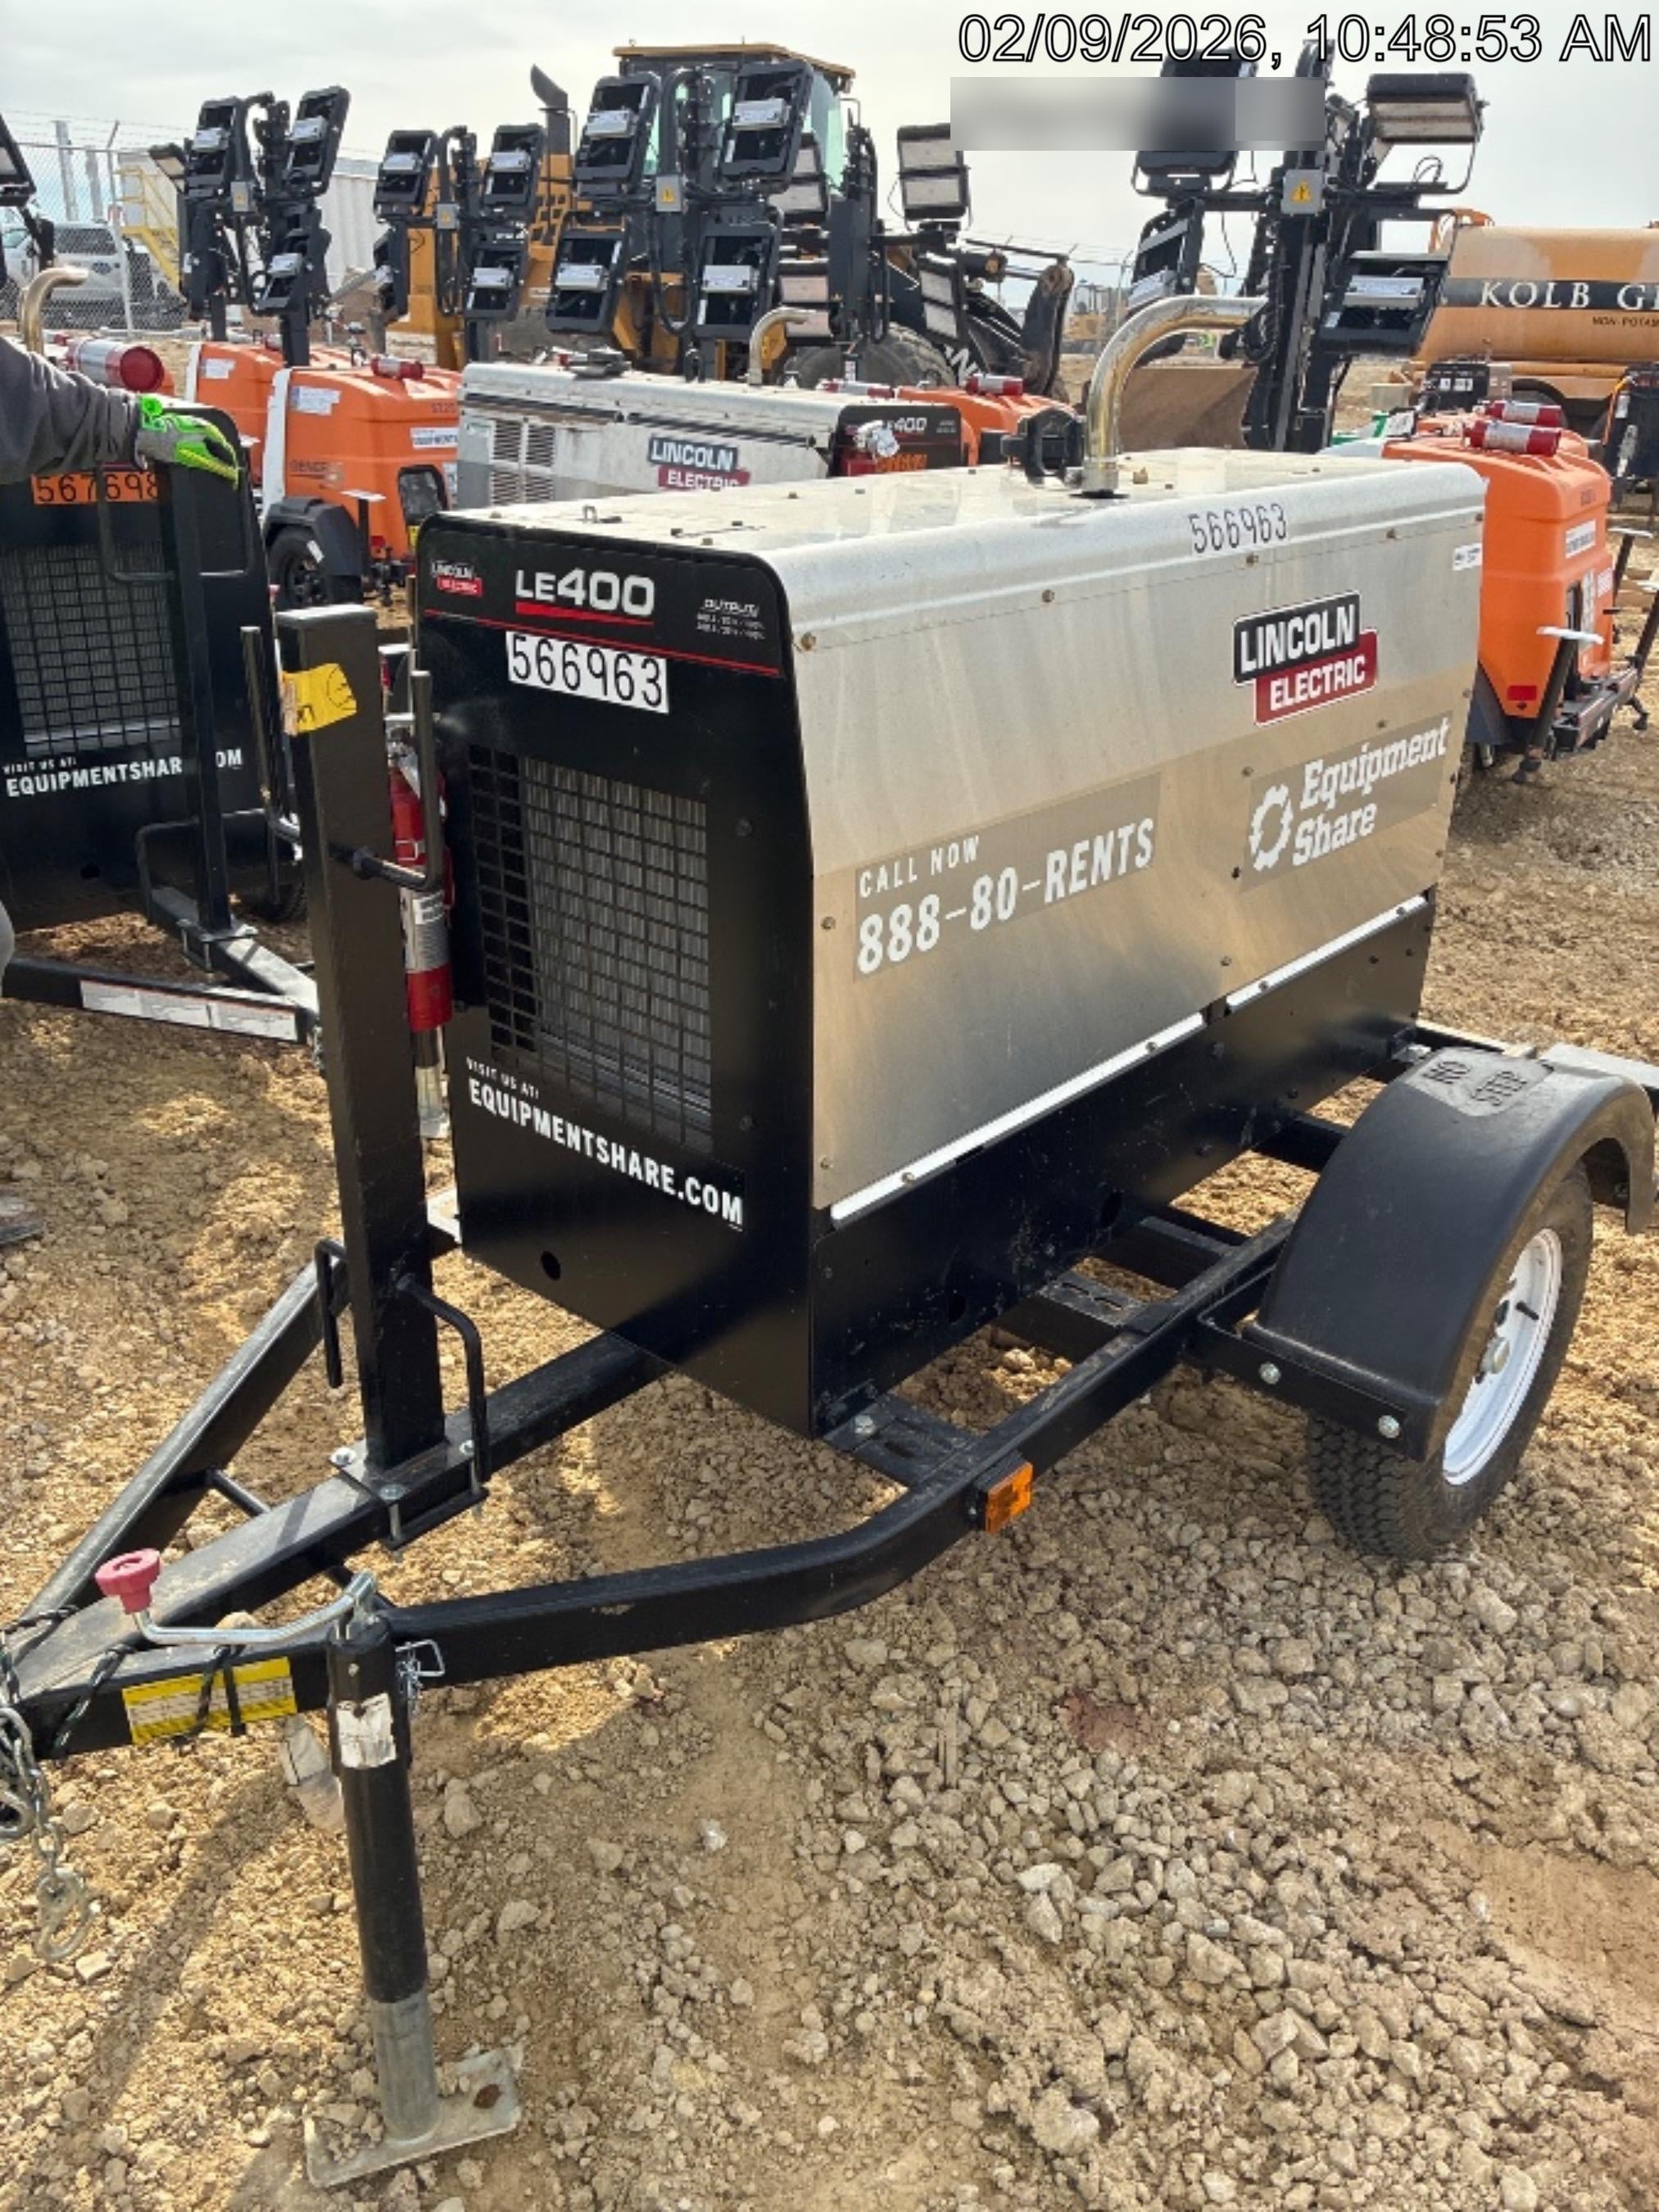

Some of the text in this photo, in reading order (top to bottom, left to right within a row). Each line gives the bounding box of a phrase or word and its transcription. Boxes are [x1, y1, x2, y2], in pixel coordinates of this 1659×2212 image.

[1480, 280, 1590, 309] KOLB
[650, 439, 733, 473] LINCOLN
[1189, 502, 1288, 554] 566963
[515, 568, 655, 616] LE400
[1240, 604, 1356, 673] LINCOLN
[512, 636, 663, 707] 566963
[1270, 655, 1366, 711] ELECTRIC
[1300, 717, 1450, 811] Equipment
[1292, 803, 1378, 867] Share
[858, 818, 1154, 975] 888-80-RENTS
[859, 836, 981, 898] CALL NOW
[469, 1077, 743, 1226] EQUIPMENTSHARE.COM
